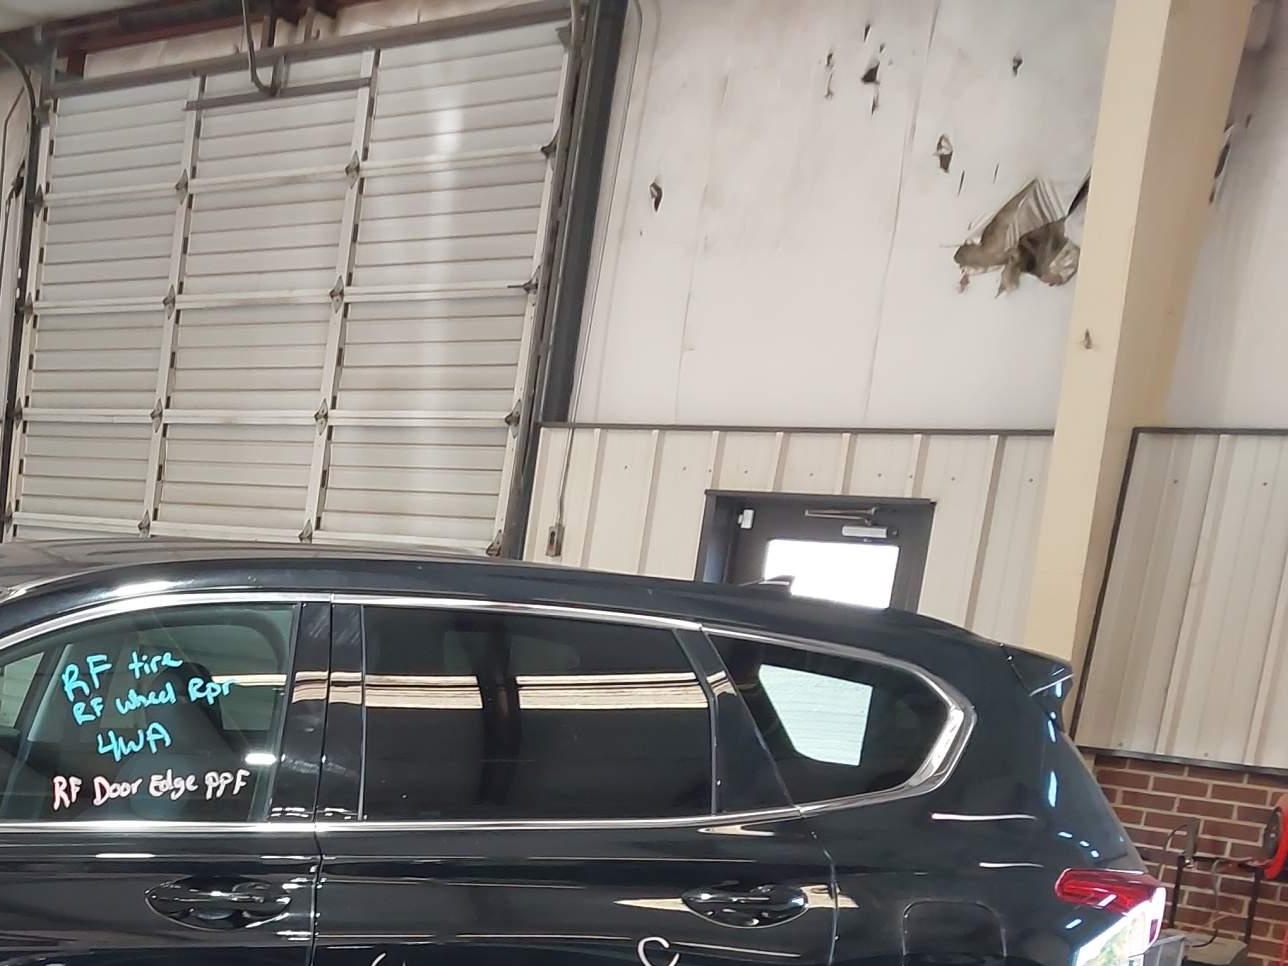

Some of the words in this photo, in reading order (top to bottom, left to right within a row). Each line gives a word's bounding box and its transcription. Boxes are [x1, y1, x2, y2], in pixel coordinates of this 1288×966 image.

[62, 654, 112, 702] RF
[128, 651, 183, 680] tire
[73, 697, 104, 726] RF
[115, 682, 176, 715] wheel
[187, 677, 237, 705] Rpr
[97, 722, 171, 763] 4WA
[52, 775, 82, 810] RF
[93, 775, 143, 807] Door
[149, 769, 198, 800] Edge
